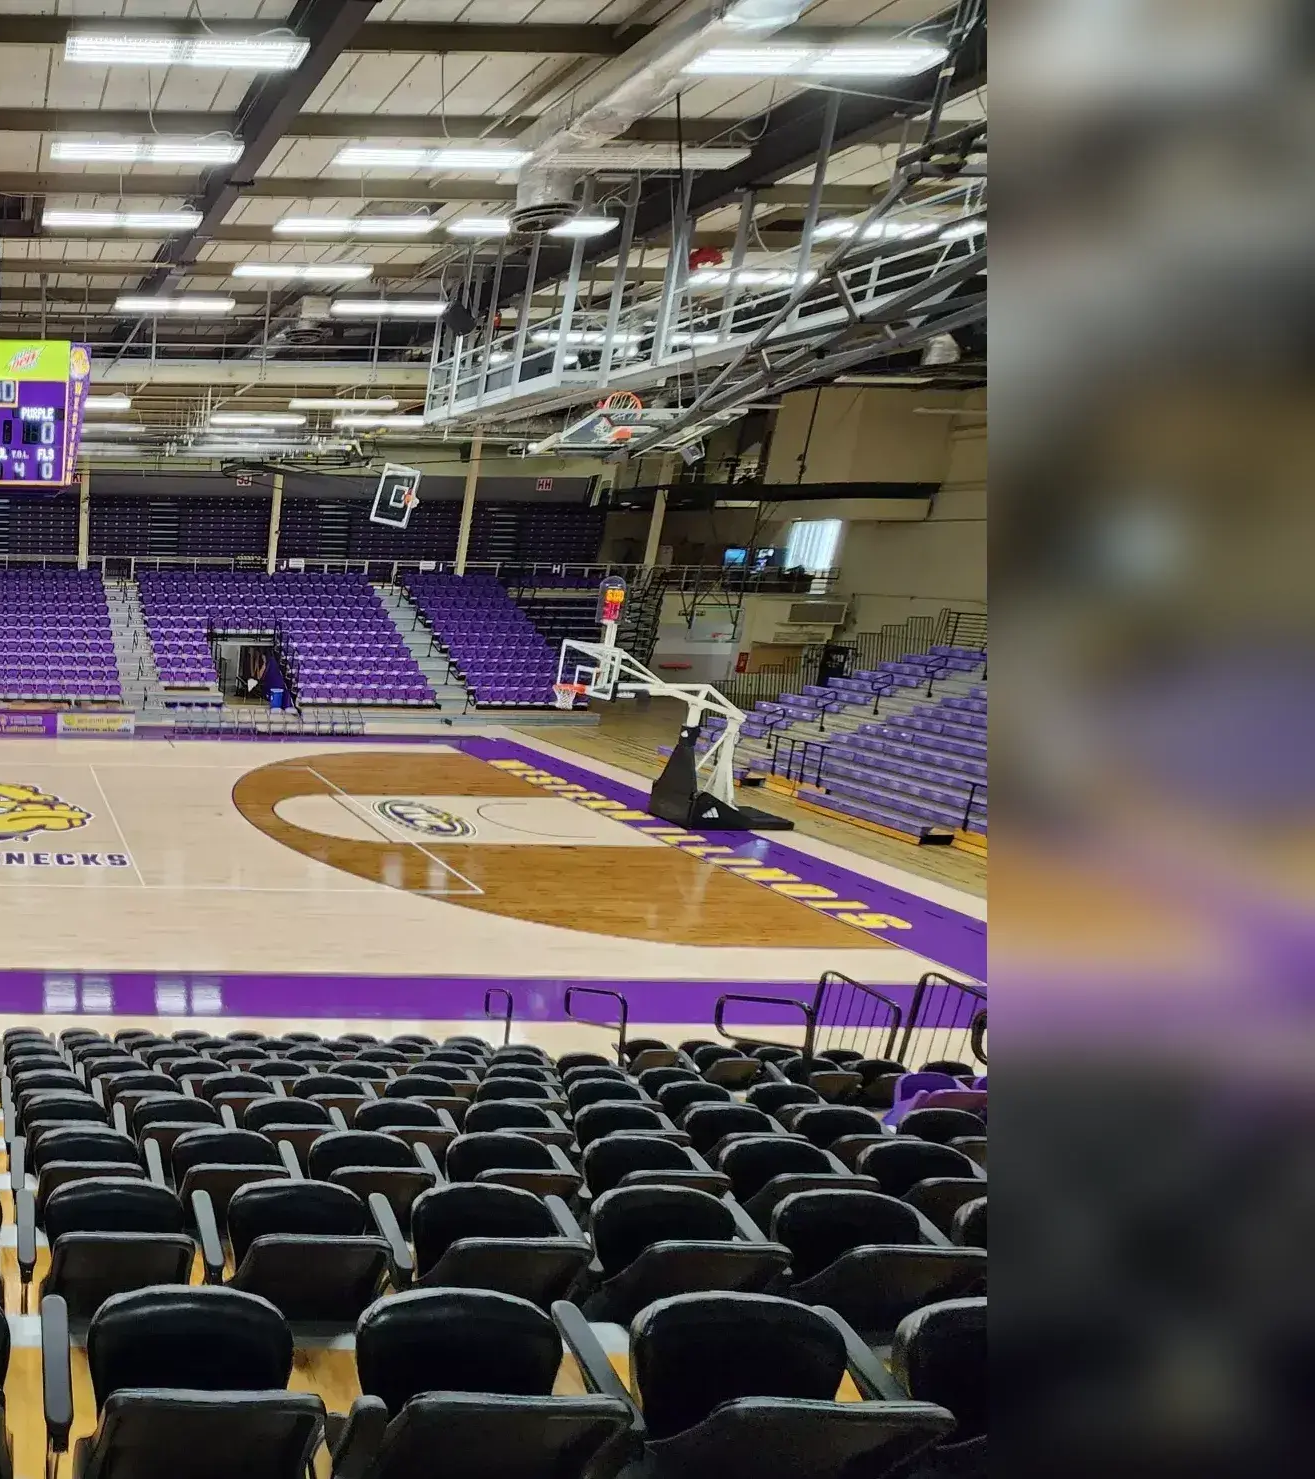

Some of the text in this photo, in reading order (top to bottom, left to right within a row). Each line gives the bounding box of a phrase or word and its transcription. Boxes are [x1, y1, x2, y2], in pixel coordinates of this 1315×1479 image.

[21, 406, 55, 420] PURPLE
[41, 421, 55, 444] 0
[37, 448, 55, 461] FLS
[14, 462, 25, 478] 4
[41, 462, 53, 479] 0
[537, 478, 551, 490] HH
[552, 564, 561, 574] H
[487, 758, 656, 821] WESTERN
[639, 827, 912, 930] ILLINOIS
